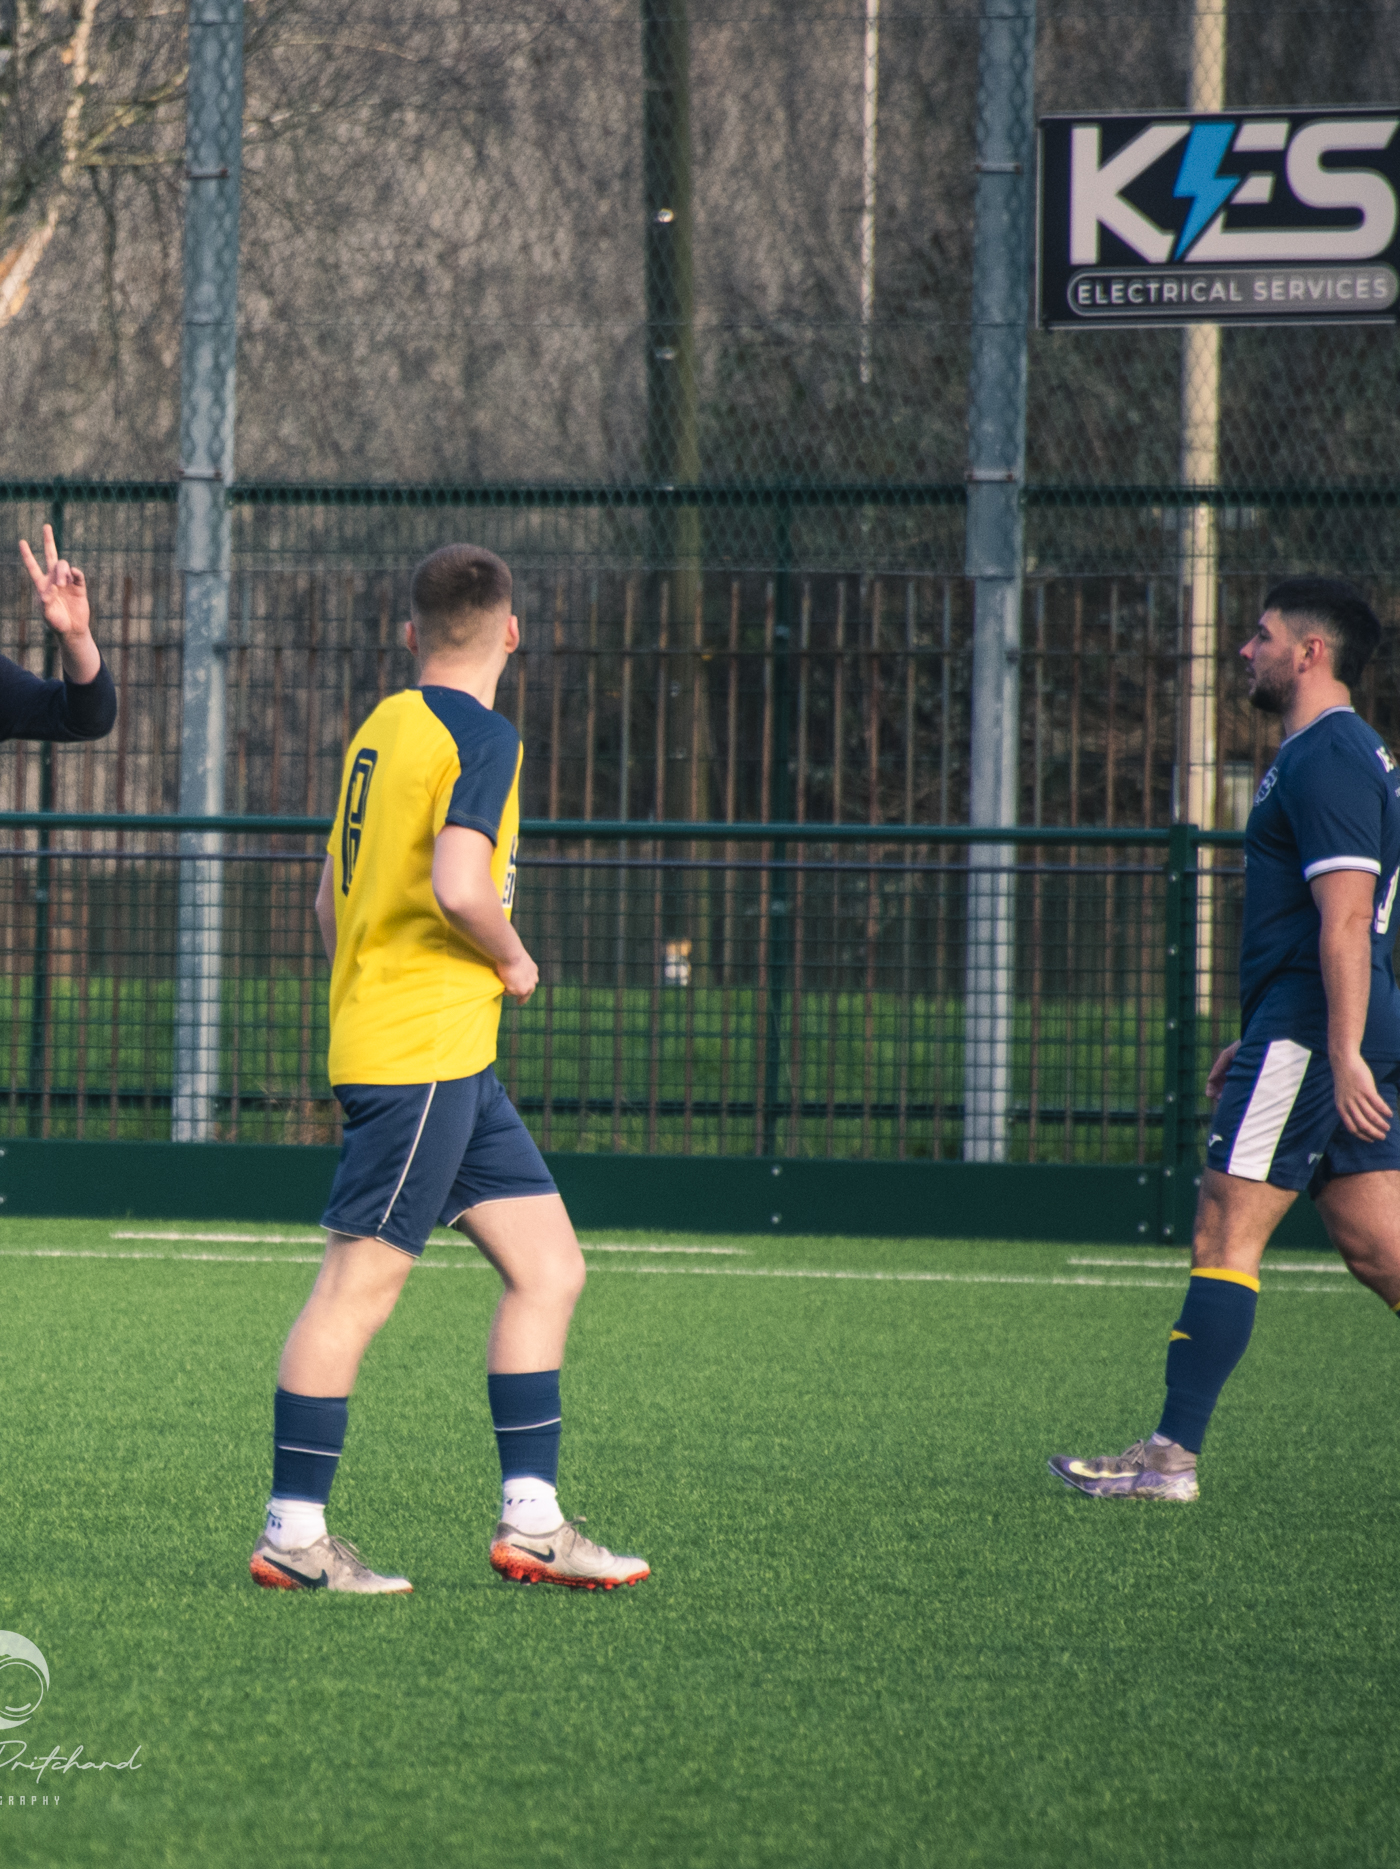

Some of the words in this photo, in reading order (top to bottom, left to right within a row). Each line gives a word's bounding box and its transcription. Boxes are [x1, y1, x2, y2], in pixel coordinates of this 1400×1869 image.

[1069, 119, 1399, 265] KES
[1077, 281, 1243, 305] ELECTRICAL
[1253, 277, 1389, 301] SERVICES
